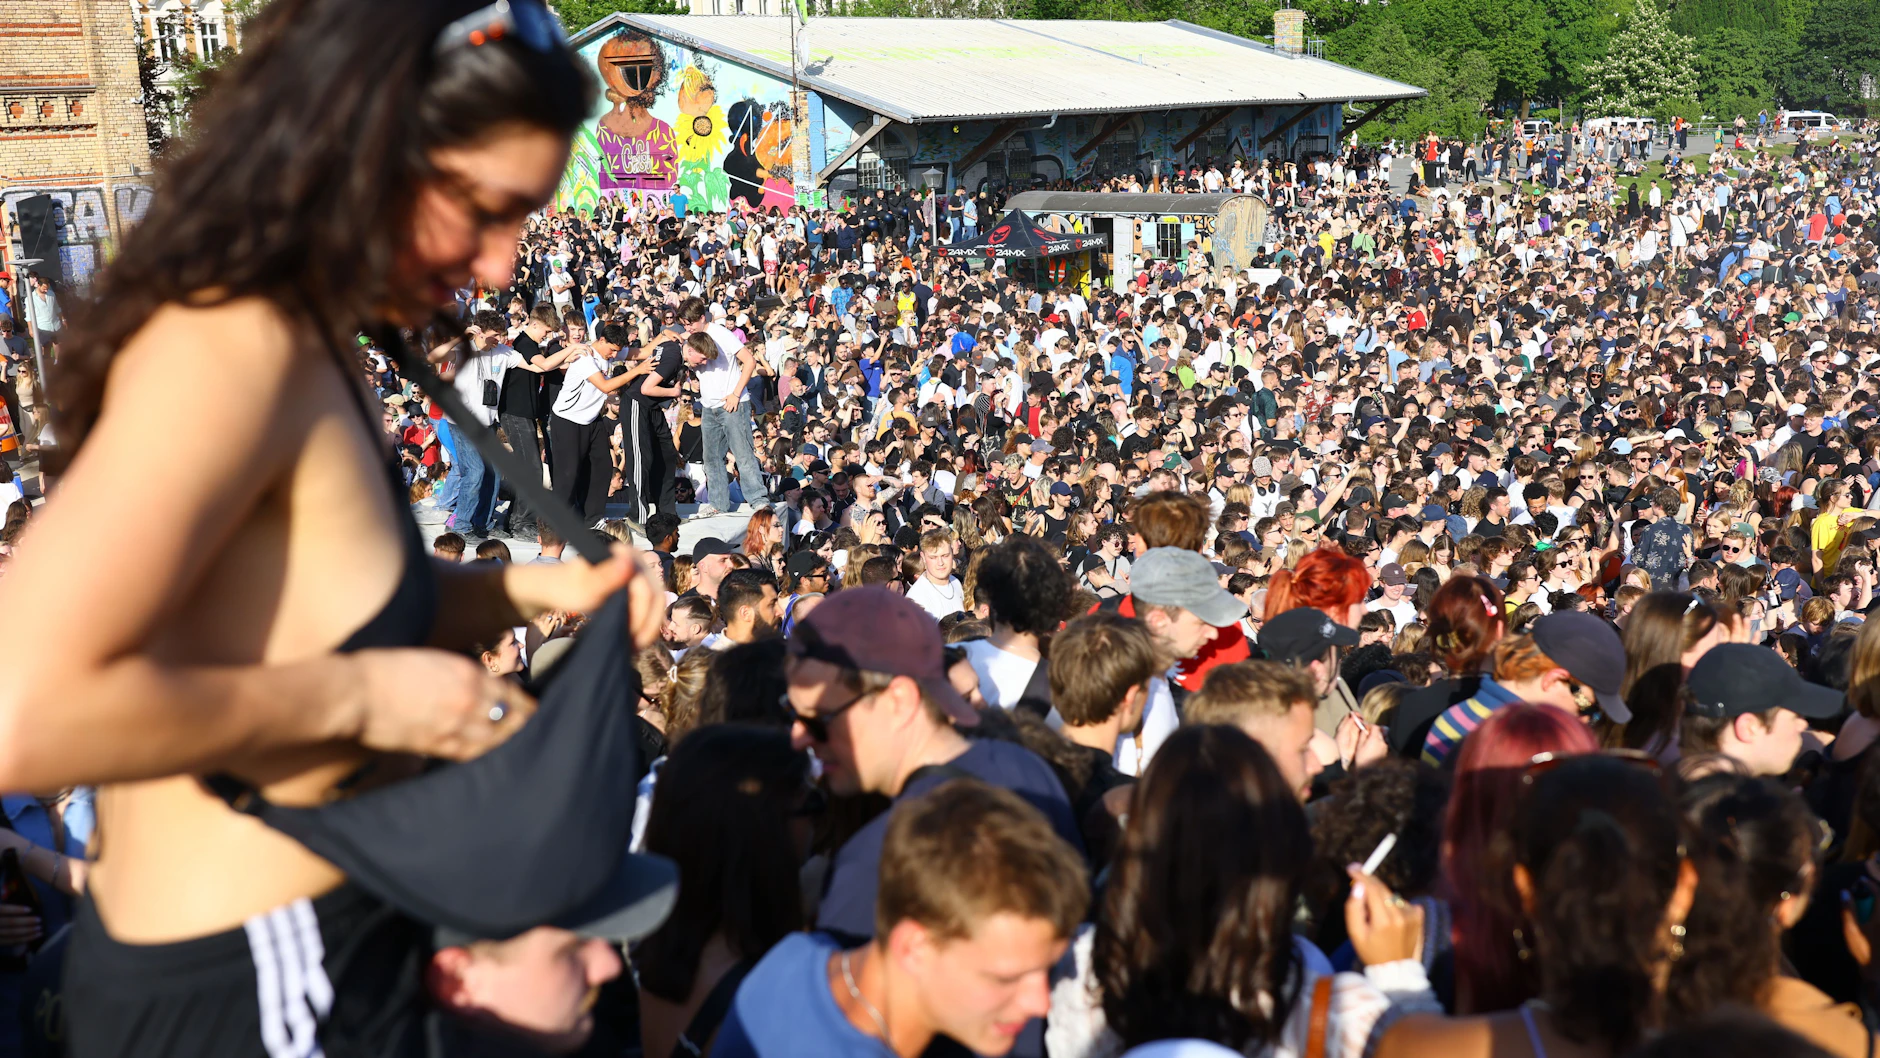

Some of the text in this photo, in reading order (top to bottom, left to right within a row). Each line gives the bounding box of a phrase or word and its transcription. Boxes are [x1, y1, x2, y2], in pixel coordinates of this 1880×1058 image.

[1082, 237, 1104, 248] 24MX
[947, 248, 978, 256] 24MX
[1047, 243, 1070, 253] 24MX
[995, 249, 1027, 257] 24MX
